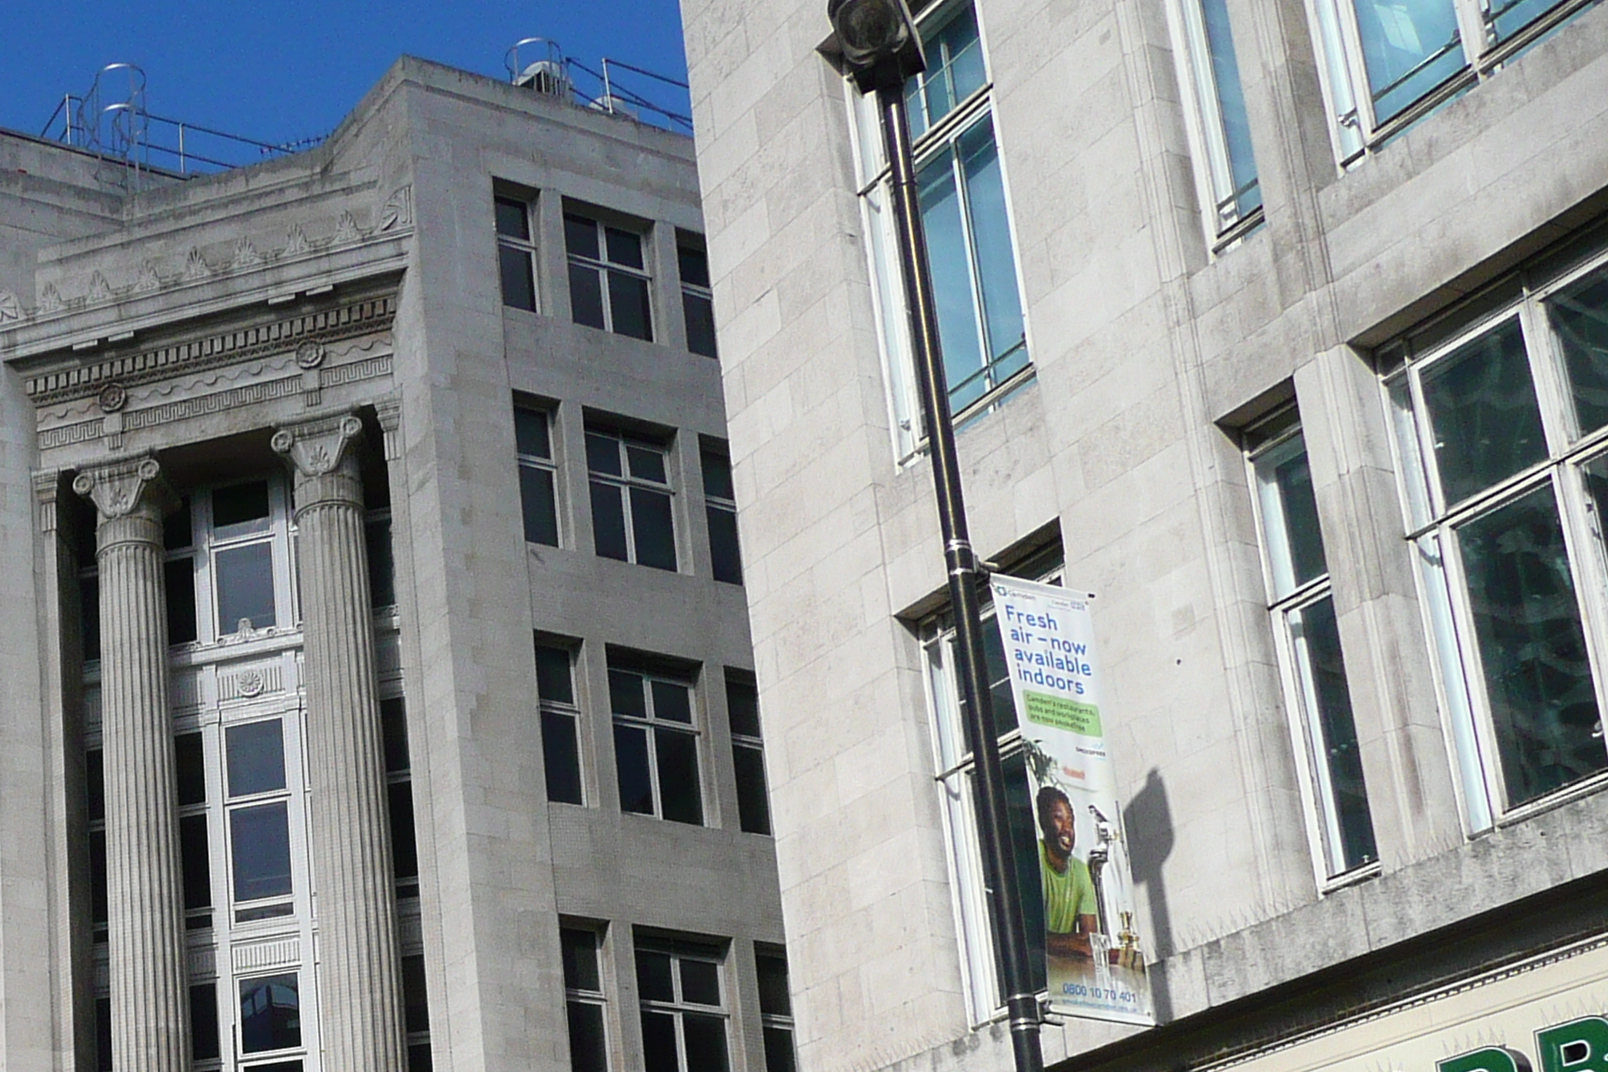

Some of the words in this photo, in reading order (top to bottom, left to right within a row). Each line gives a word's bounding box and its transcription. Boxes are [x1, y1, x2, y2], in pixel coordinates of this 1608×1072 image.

[1005, 604, 1058, 631] Fresh
[1011, 626, 1033, 643] air
[1051, 637, 1086, 656] now
[1014, 647, 1092, 676] available
[1017, 663, 1085, 695] indoors
[1062, 982, 1088, 997] 0800
[1090, 987, 1102, 999] 10
[1104, 988, 1117, 1001] 70
[1119, 991, 1137, 1003] 401
